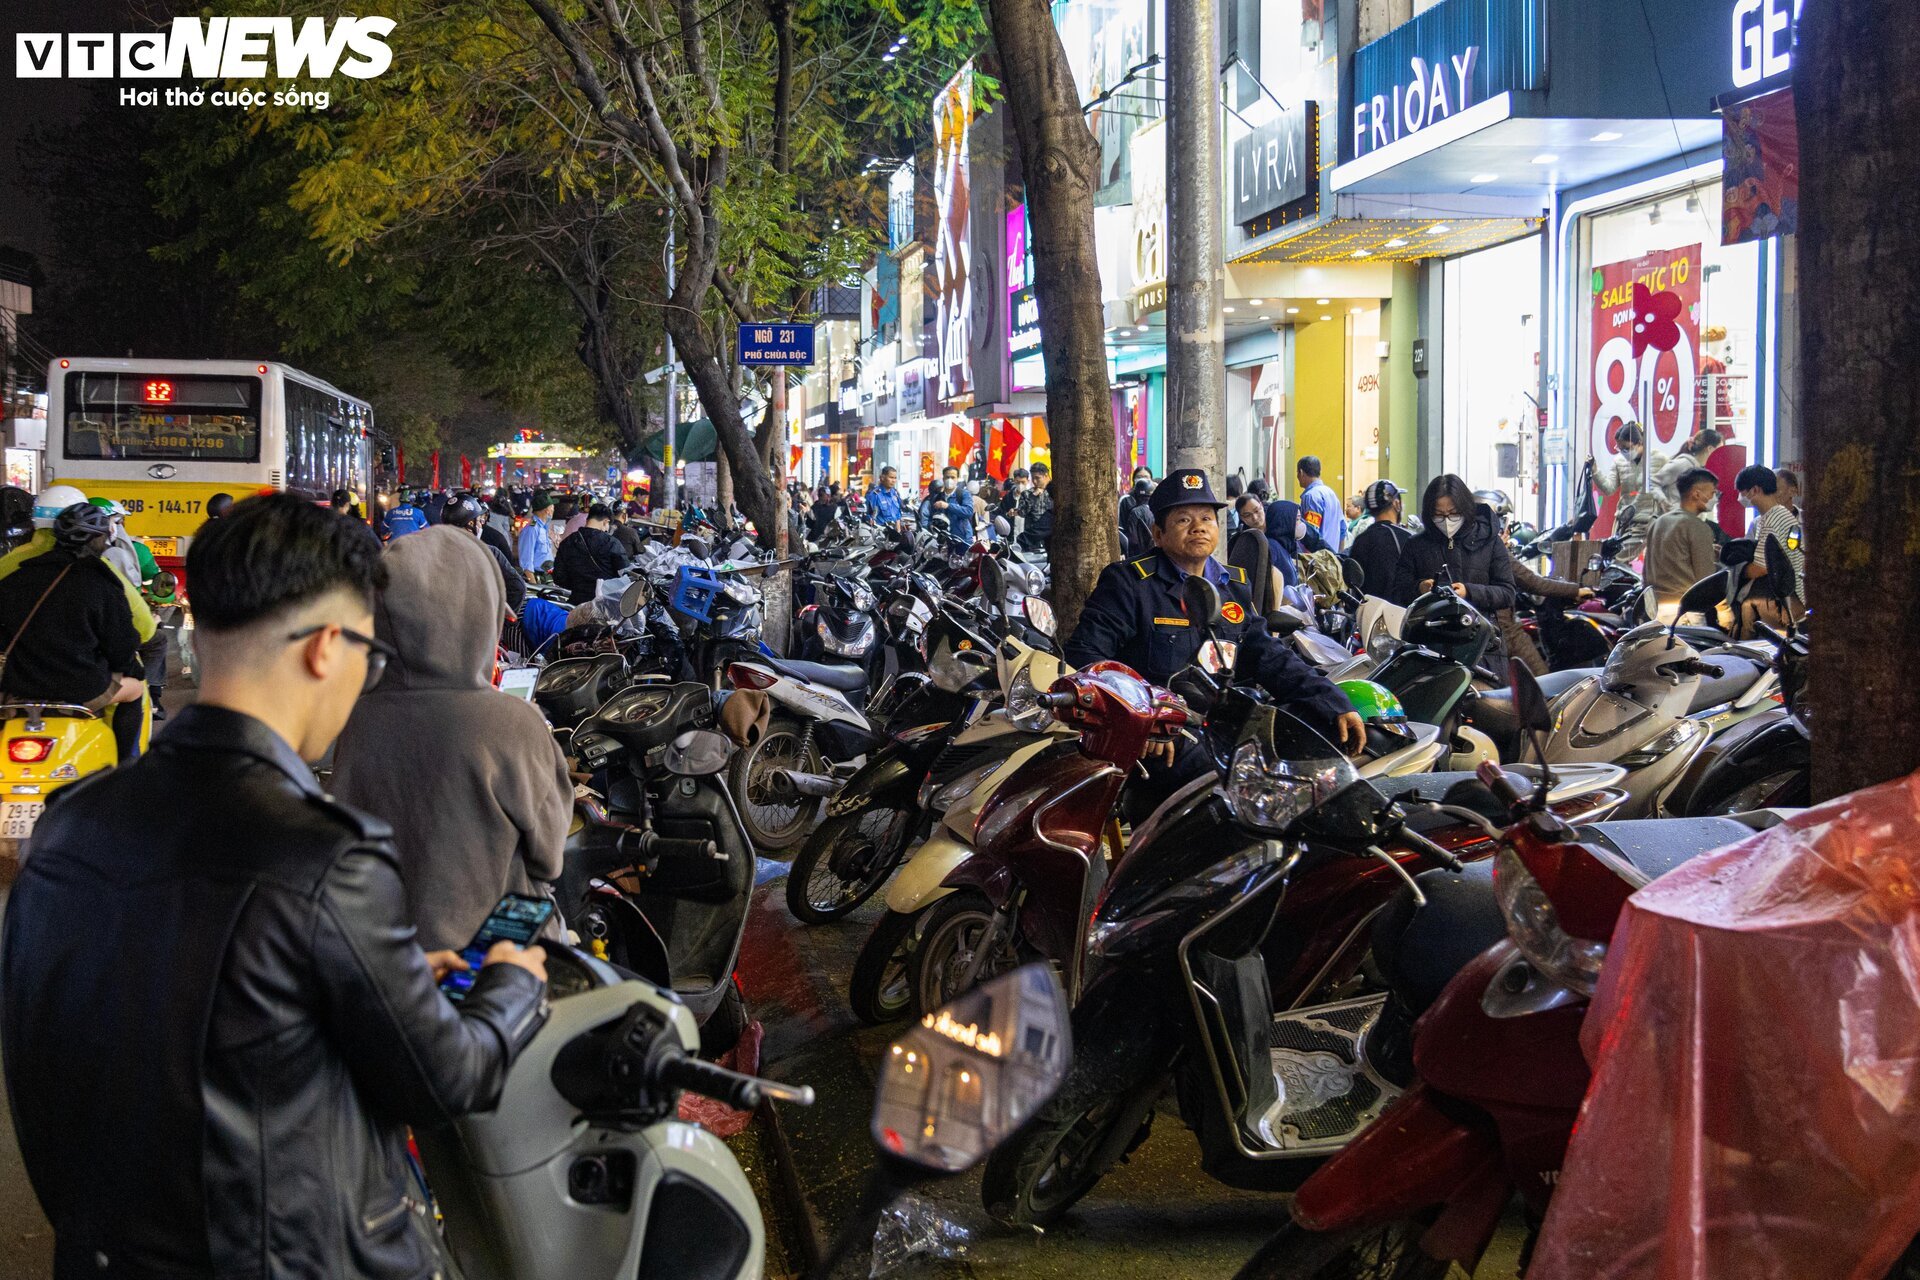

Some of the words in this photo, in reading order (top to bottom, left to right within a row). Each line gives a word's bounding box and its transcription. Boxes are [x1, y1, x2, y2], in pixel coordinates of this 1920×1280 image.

[1732, 0, 1803, 88] GE
[1240, 131, 1298, 203] LYRA
[1601, 281, 1633, 310] SALE
[1670, 257, 1689, 287] TO
[754, 327, 773, 343] NGÕ
[779, 329, 795, 343] 231
[744, 348, 762, 359] PHỐ
[764, 349, 787, 359] CHÙA
[789, 349, 807, 361] BỘC
[158, 500, 201, 514] 144.17
